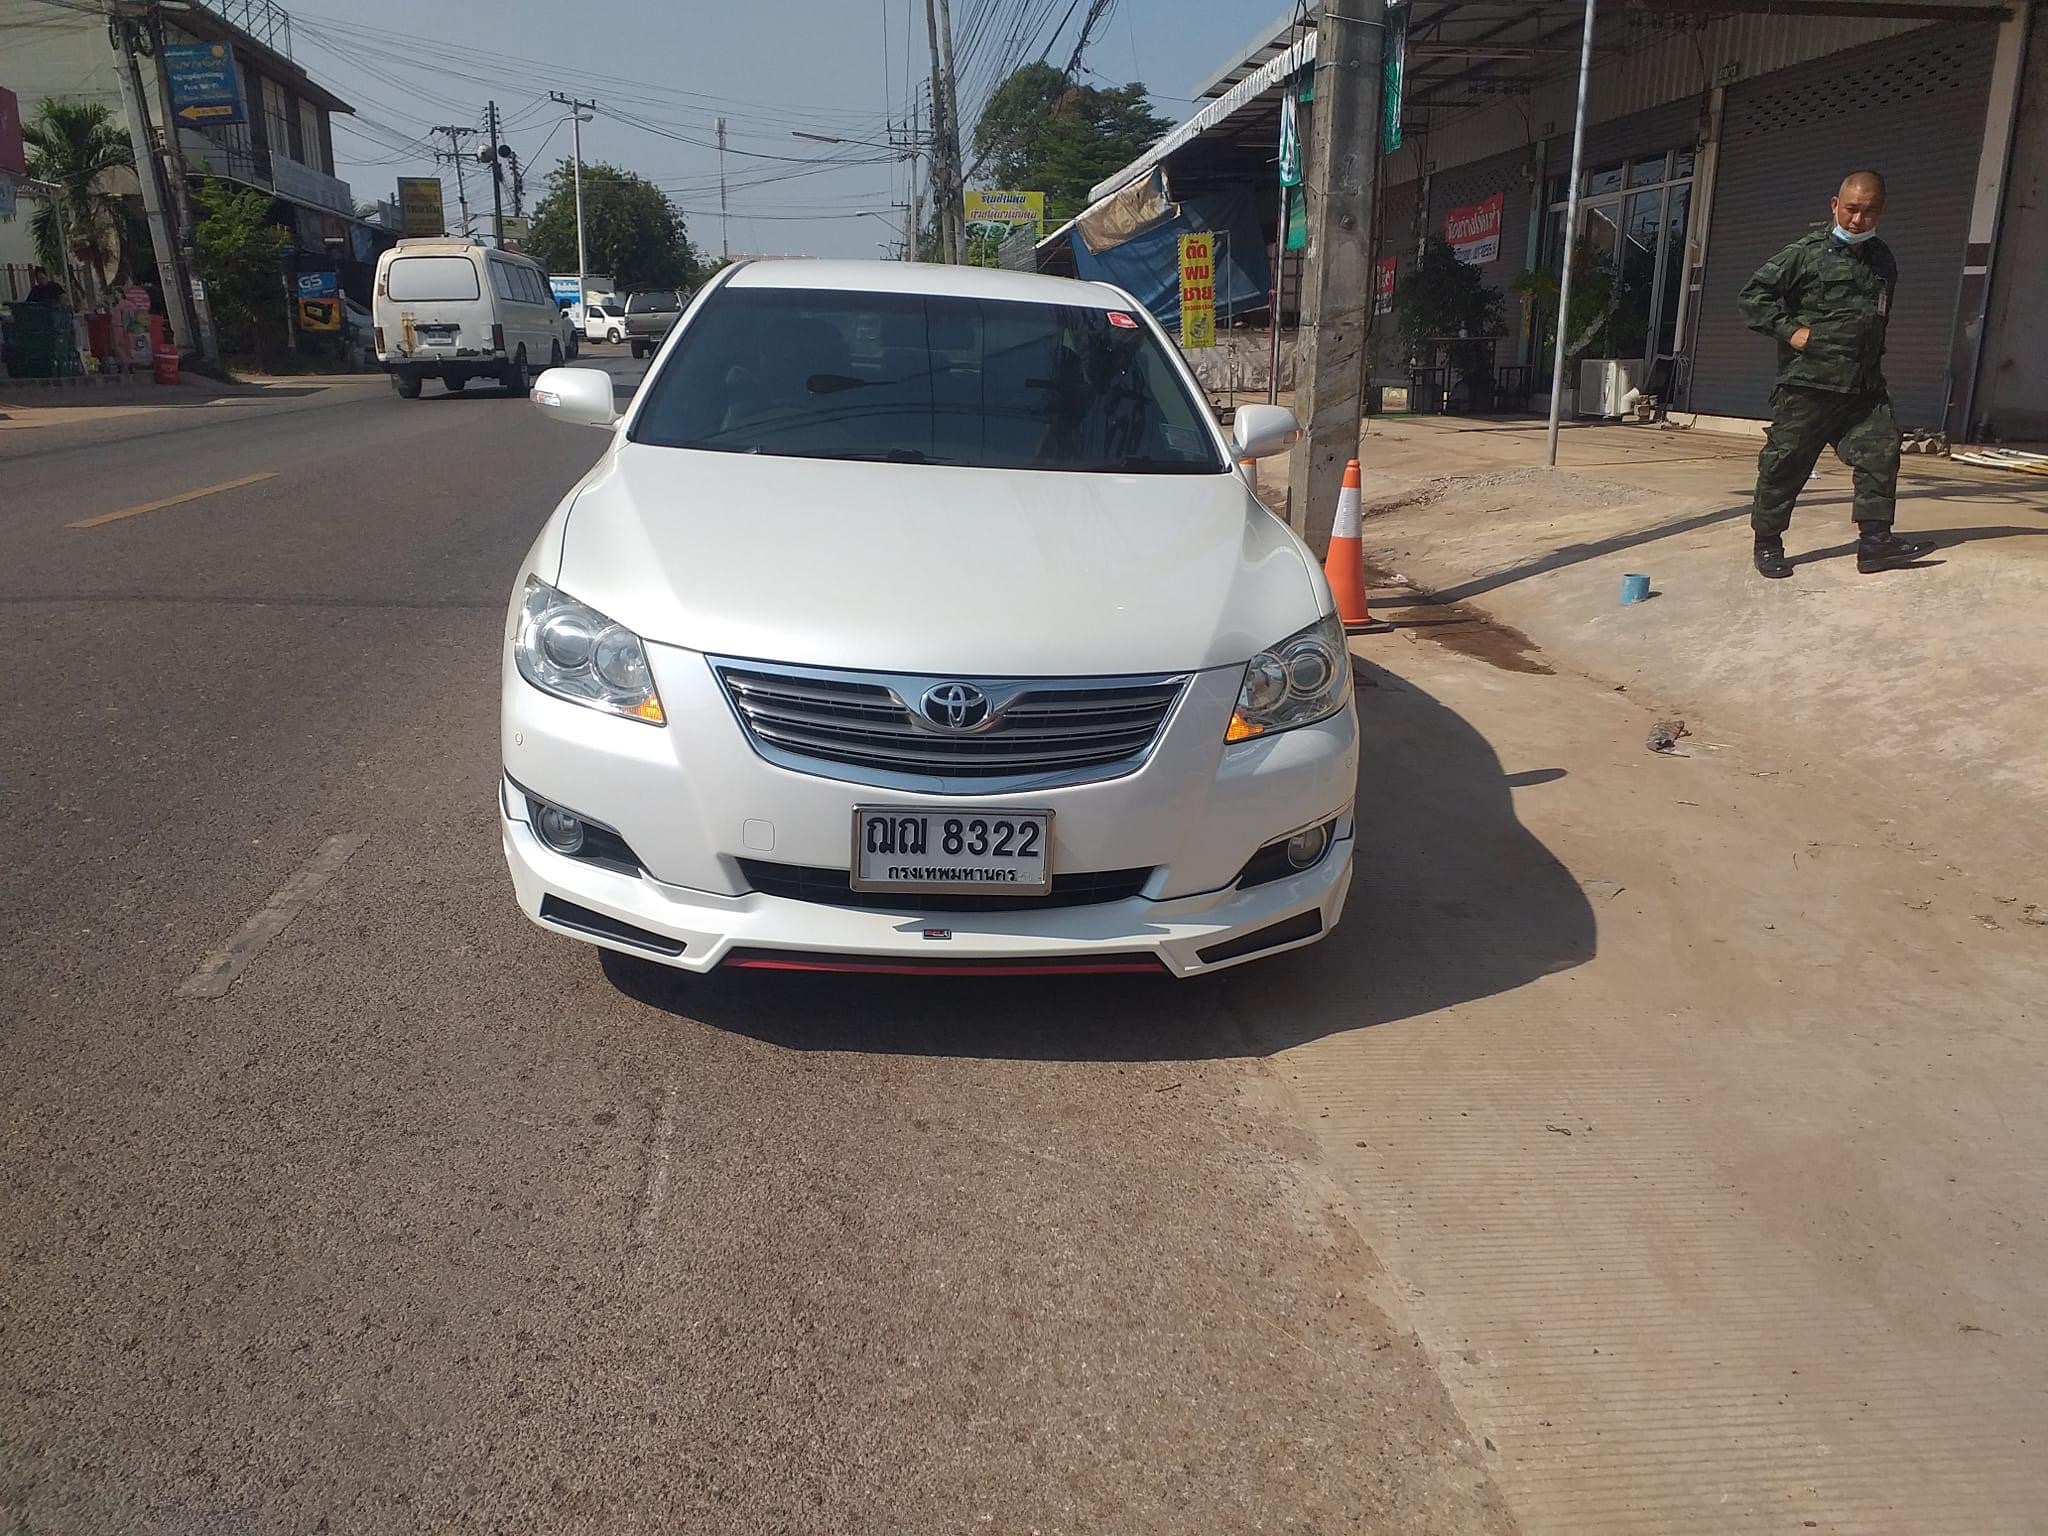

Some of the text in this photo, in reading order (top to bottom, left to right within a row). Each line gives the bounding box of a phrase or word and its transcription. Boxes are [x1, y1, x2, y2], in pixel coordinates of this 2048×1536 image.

[1185, 239, 1208, 260] ตัด
[298, 273, 323, 289] GS
[1184, 265, 1210, 281] ผม
[1183, 286, 1213, 302] ชาย
[865, 816, 1041, 858] ฌฌ 8322
[887, 865, 1017, 882] กรงเทพมหานคร
